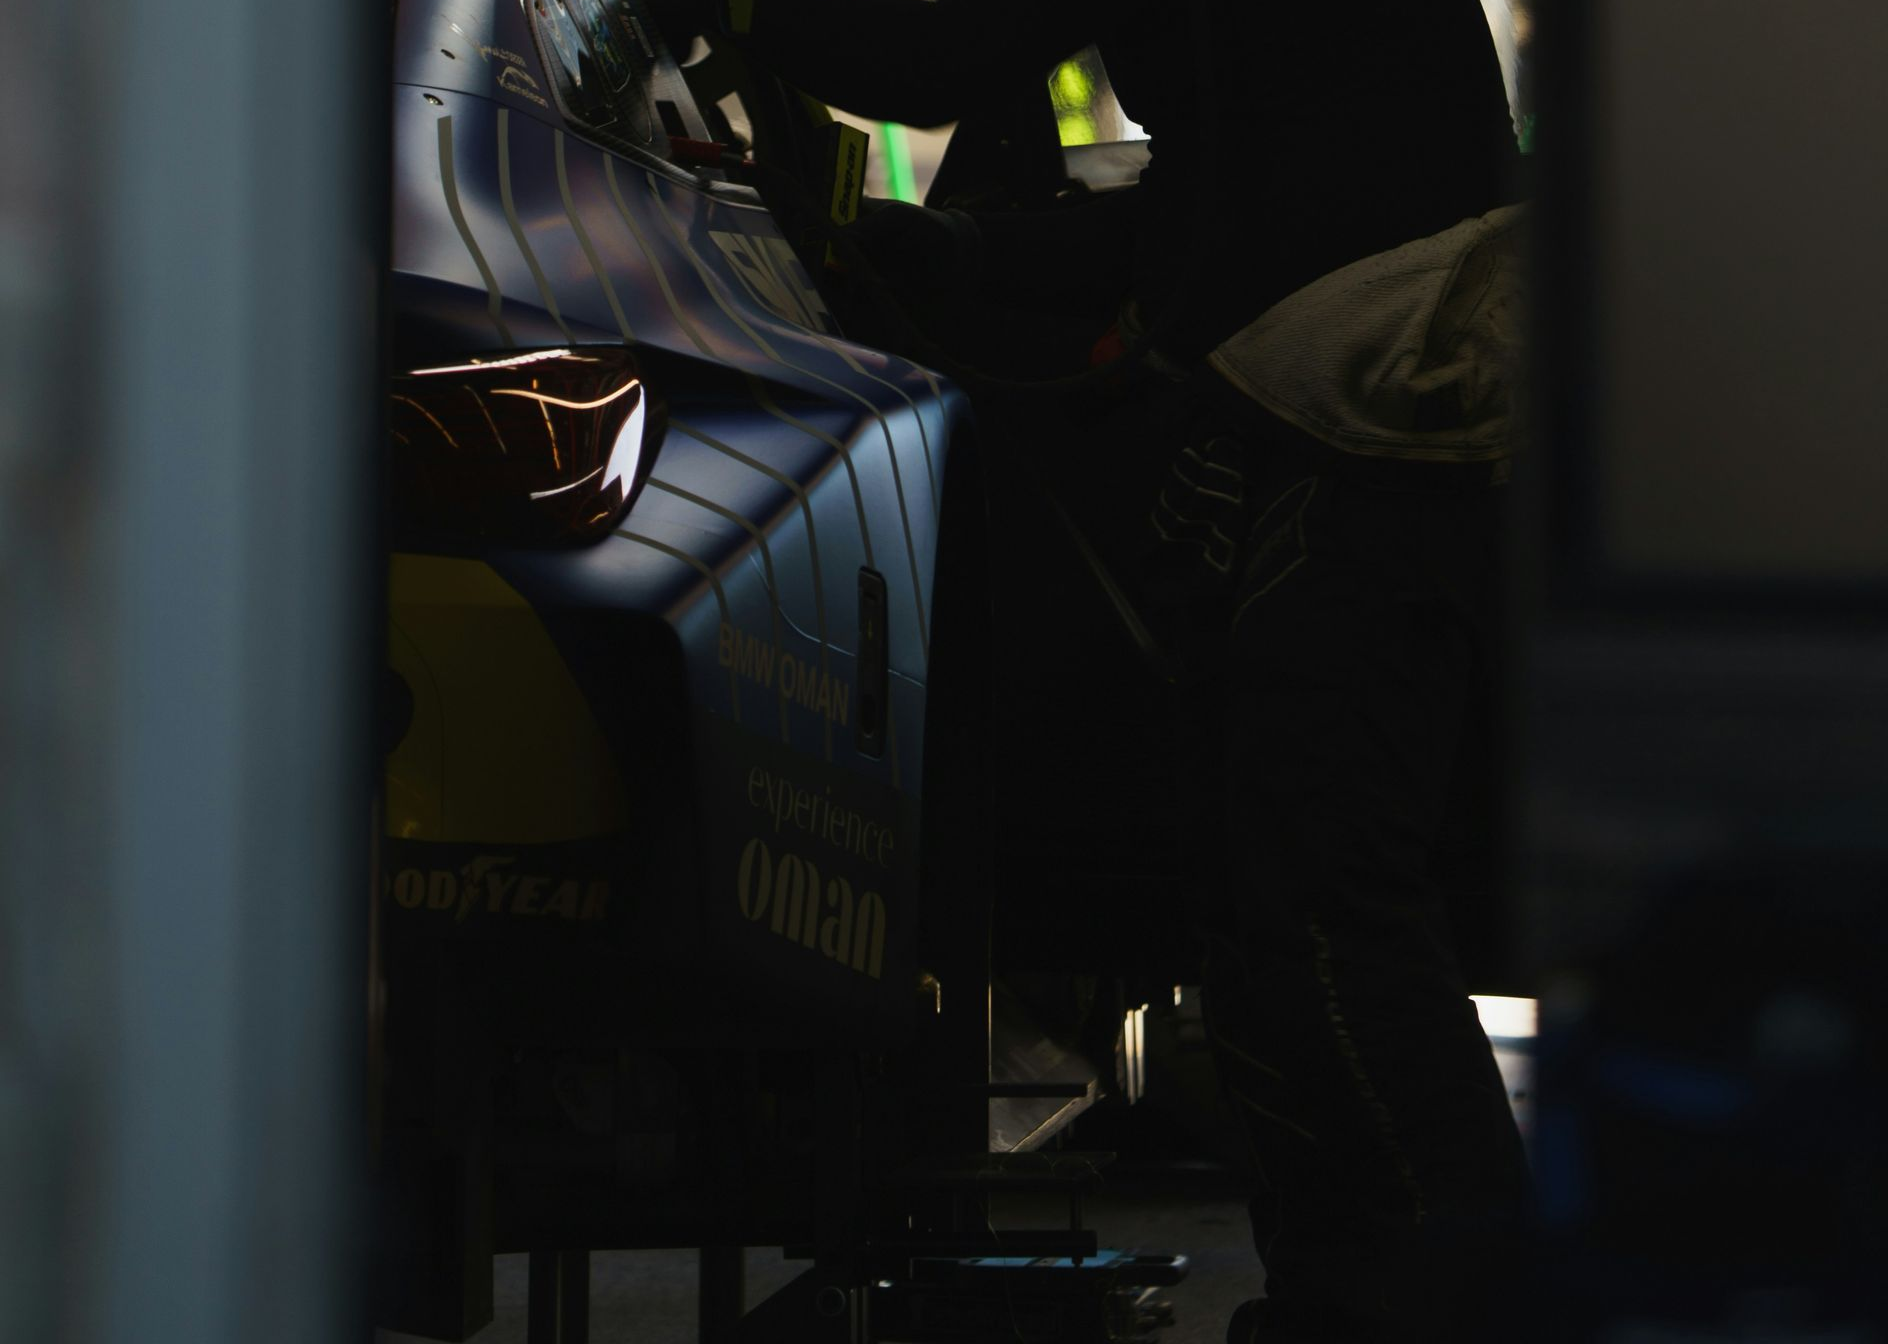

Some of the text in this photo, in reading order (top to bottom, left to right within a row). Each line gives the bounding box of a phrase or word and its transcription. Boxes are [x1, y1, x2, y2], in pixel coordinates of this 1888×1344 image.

[718, 622, 849, 726] BMW OMAN
[747, 765, 894, 868] experience
[384, 866, 609, 920] ODYEAR
[737, 837, 887, 980] oman
